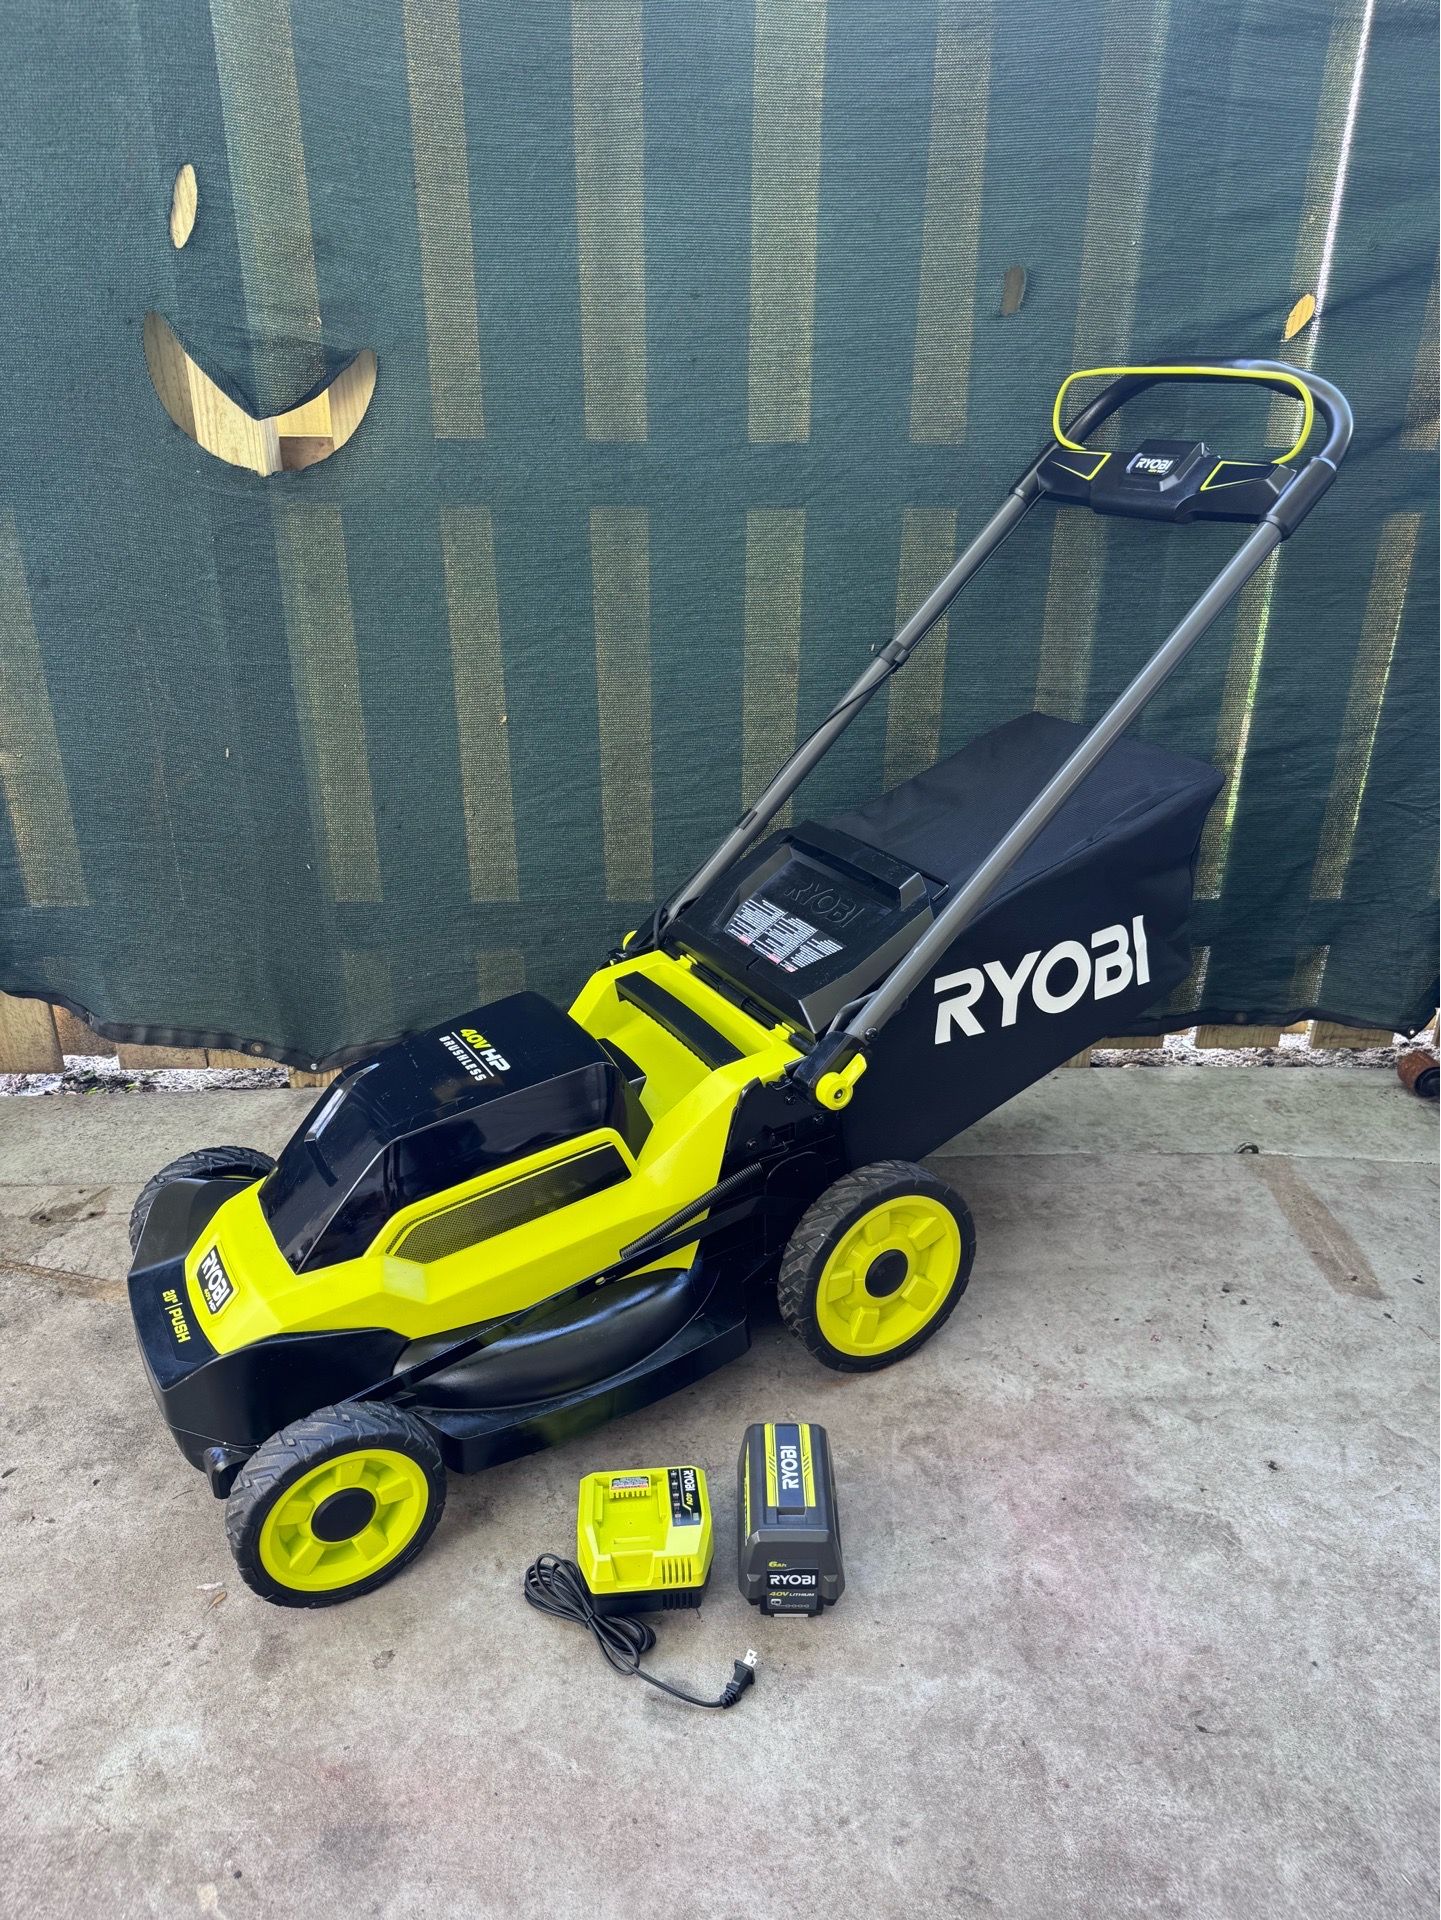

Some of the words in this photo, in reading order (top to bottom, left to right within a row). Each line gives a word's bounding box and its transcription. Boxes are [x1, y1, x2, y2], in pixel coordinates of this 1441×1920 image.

[1135, 457, 1173, 470] RYOBI
[784, 882, 865, 928] RYOBI
[934, 915, 1150, 1045] RYOBI
[439, 1035, 487, 1081] BRUSHLESS
[460, 1029, 492, 1049] 40V
[480, 1048, 511, 1071] HP
[201, 1249, 231, 1307] RYOBI
[169, 1307, 191, 1343] PUSH
[683, 1470, 695, 1492] RYOBI
[780, 1445, 800, 1489] RYOBI
[685, 1493, 694, 1506] 40V
[769, 1574, 816, 1585] RYOBI
